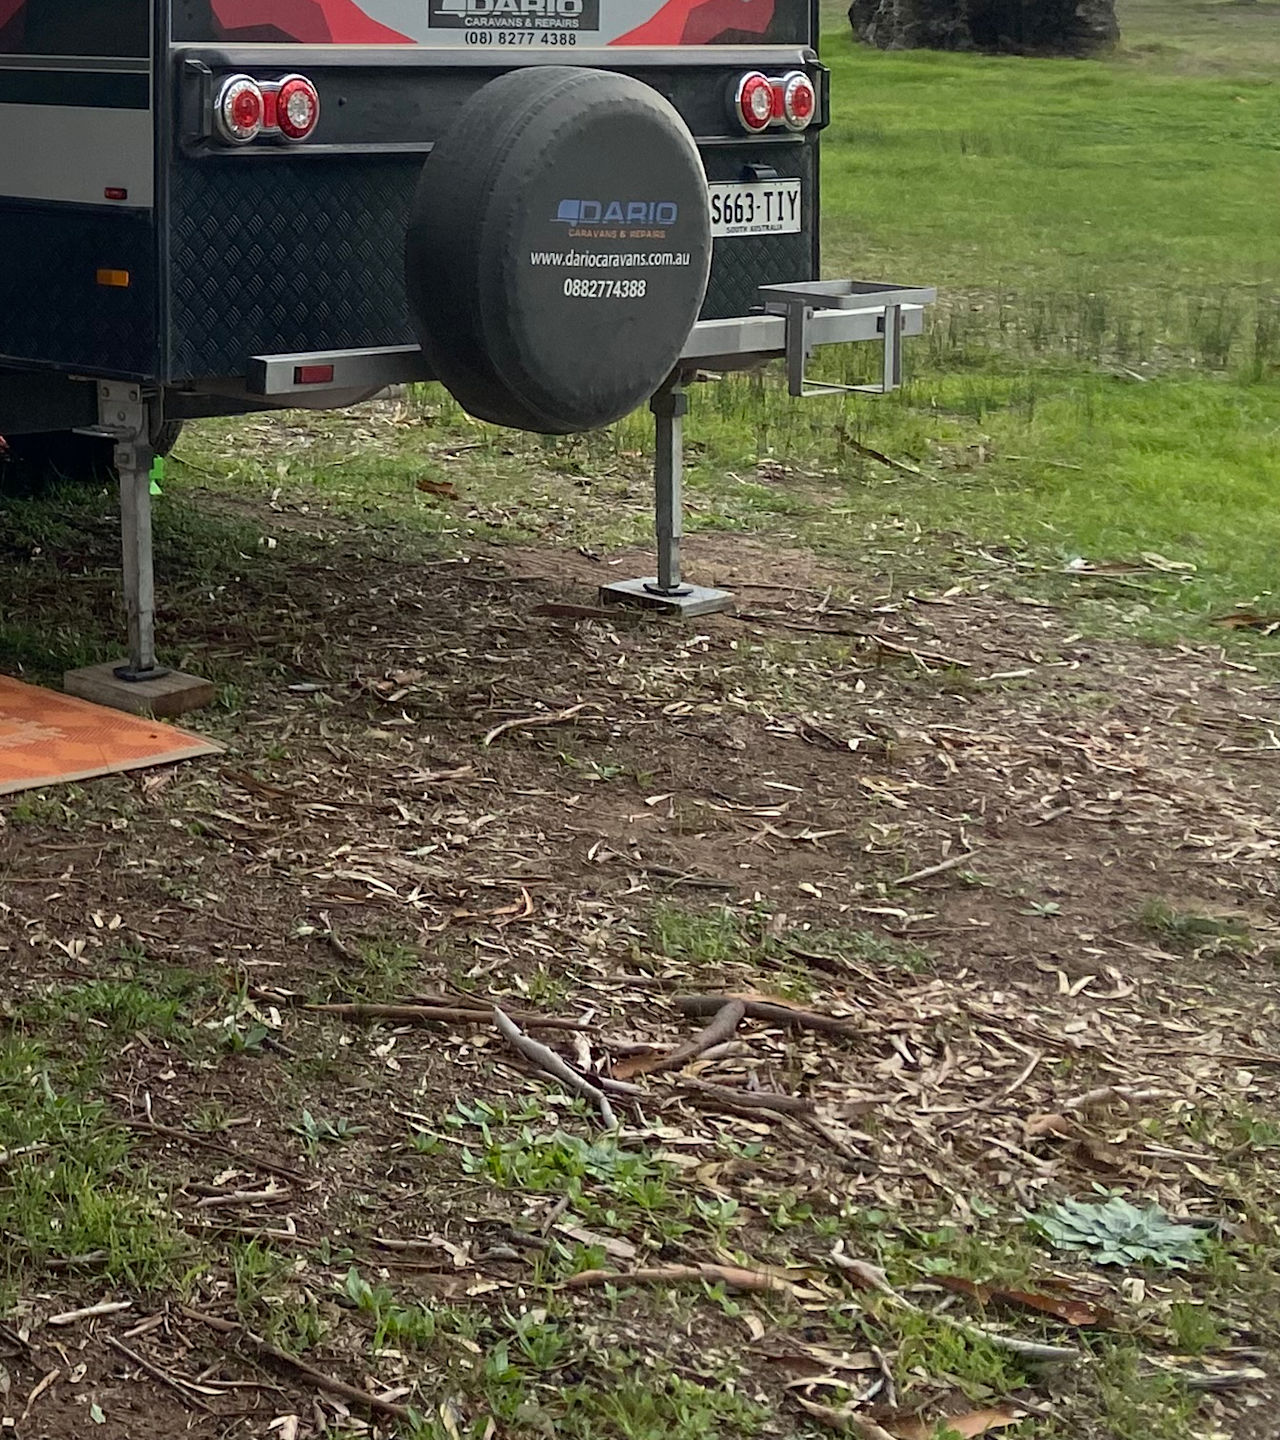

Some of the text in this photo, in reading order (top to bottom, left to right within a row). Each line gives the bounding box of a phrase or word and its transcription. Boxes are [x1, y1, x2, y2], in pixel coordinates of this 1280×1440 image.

[465, 17, 580, 28] CARAVANS & REPAIRS
[465, 31, 577, 46] (08) 8277 4388
[580, 200, 678, 225] DARIO
[568, 228, 617, 239] CARAVANS
[630, 229, 666, 239] REPAIRS
[530, 248, 690, 268] www.dariocaravans.com.au
[563, 278, 646, 298] 0882774388
